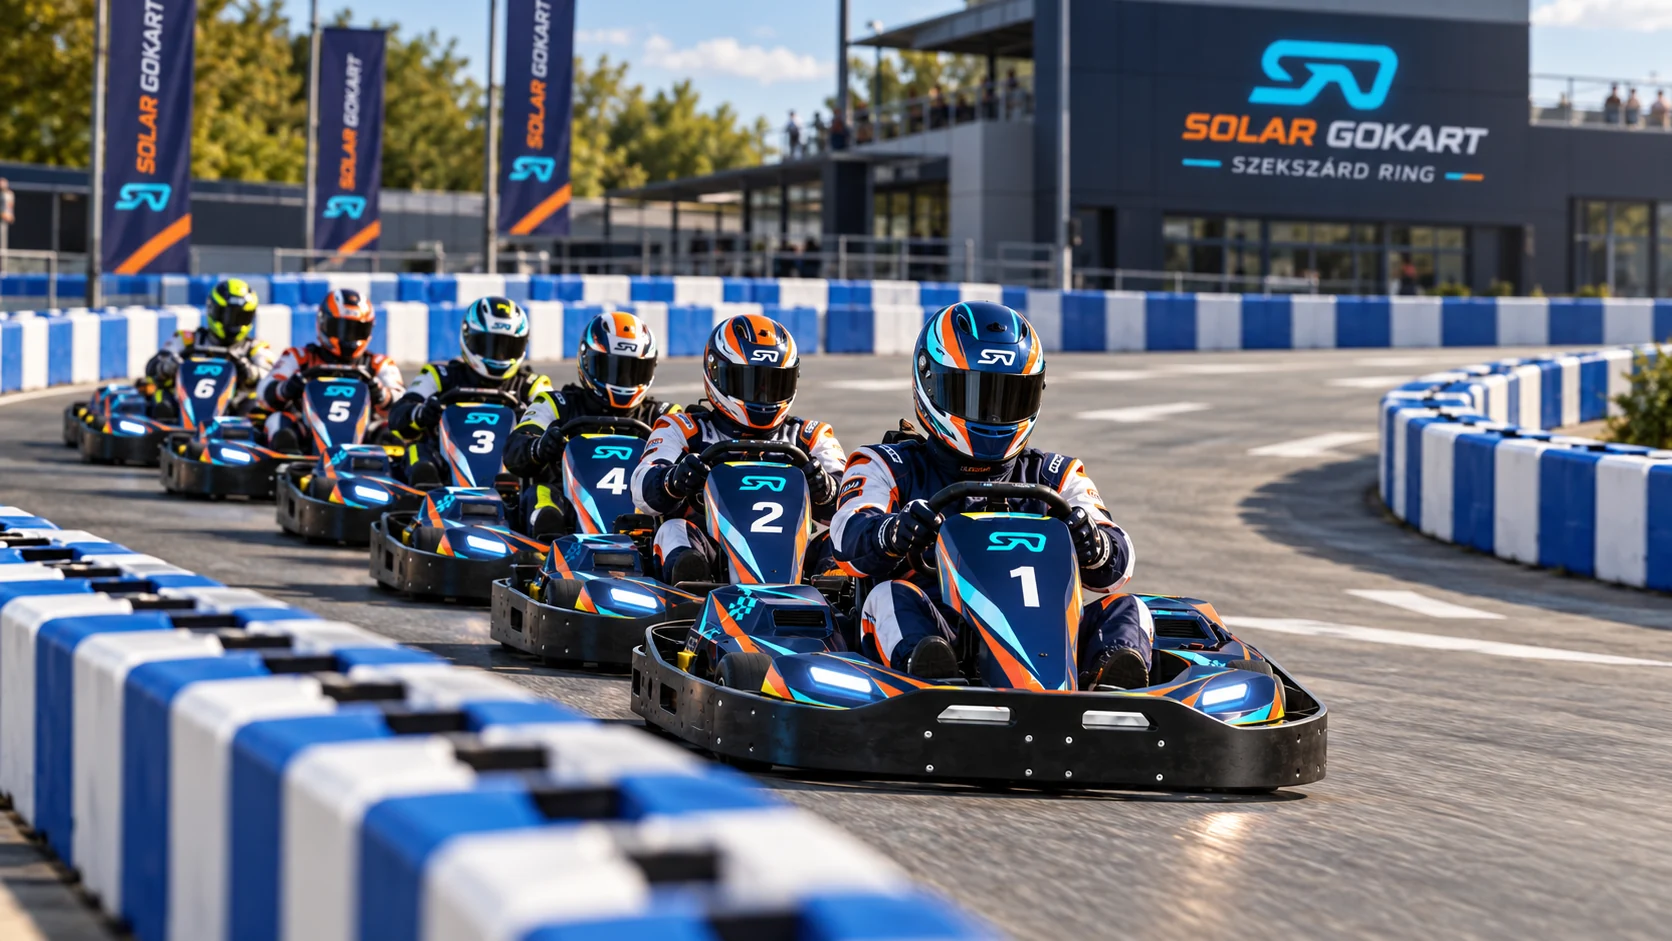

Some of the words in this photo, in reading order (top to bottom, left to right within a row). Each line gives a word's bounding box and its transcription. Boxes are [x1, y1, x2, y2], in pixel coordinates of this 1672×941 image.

[140, 0, 164, 93] GOKART
[531, 0, 551, 78] GOKART
[343, 53, 363, 127] GOKART
[136, 95, 158, 174] SOLAR
[526, 79, 547, 149] SOLAR
[1182, 112, 1317, 147] SOLAR
[1326, 120, 1489, 155] GOKART
[339, 128, 358, 190] SOLAR
[1231, 157, 1370, 180] SZEKSZÁRD
[1378, 164, 1436, 183] RING
[194, 378, 217, 398] 6
[327, 401, 351, 423] 5
[468, 430, 496, 454] 3
[596, 467, 628, 495] 4
[750, 501, 784, 534] 2
[1009, 565, 1041, 608] 1
